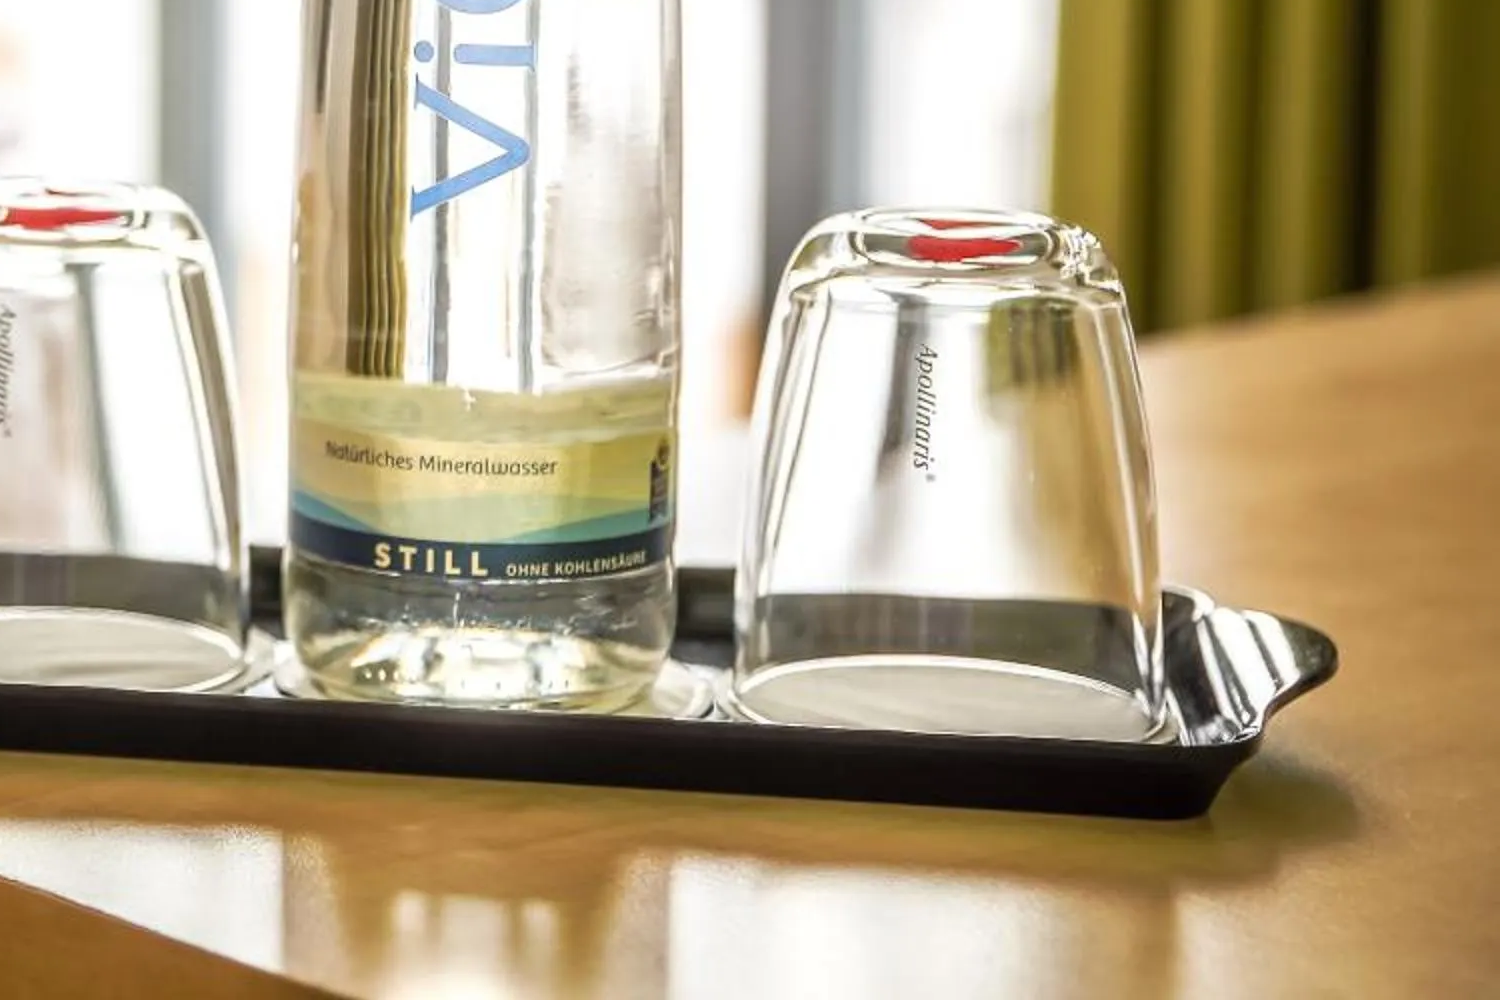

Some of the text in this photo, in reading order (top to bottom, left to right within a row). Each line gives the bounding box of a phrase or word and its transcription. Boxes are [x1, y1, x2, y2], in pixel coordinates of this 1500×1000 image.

[326, 440, 559, 477] Natürliches Mineralwasser
[374, 542, 489, 577] STILL
[506, 562, 550, 577] OHNE
